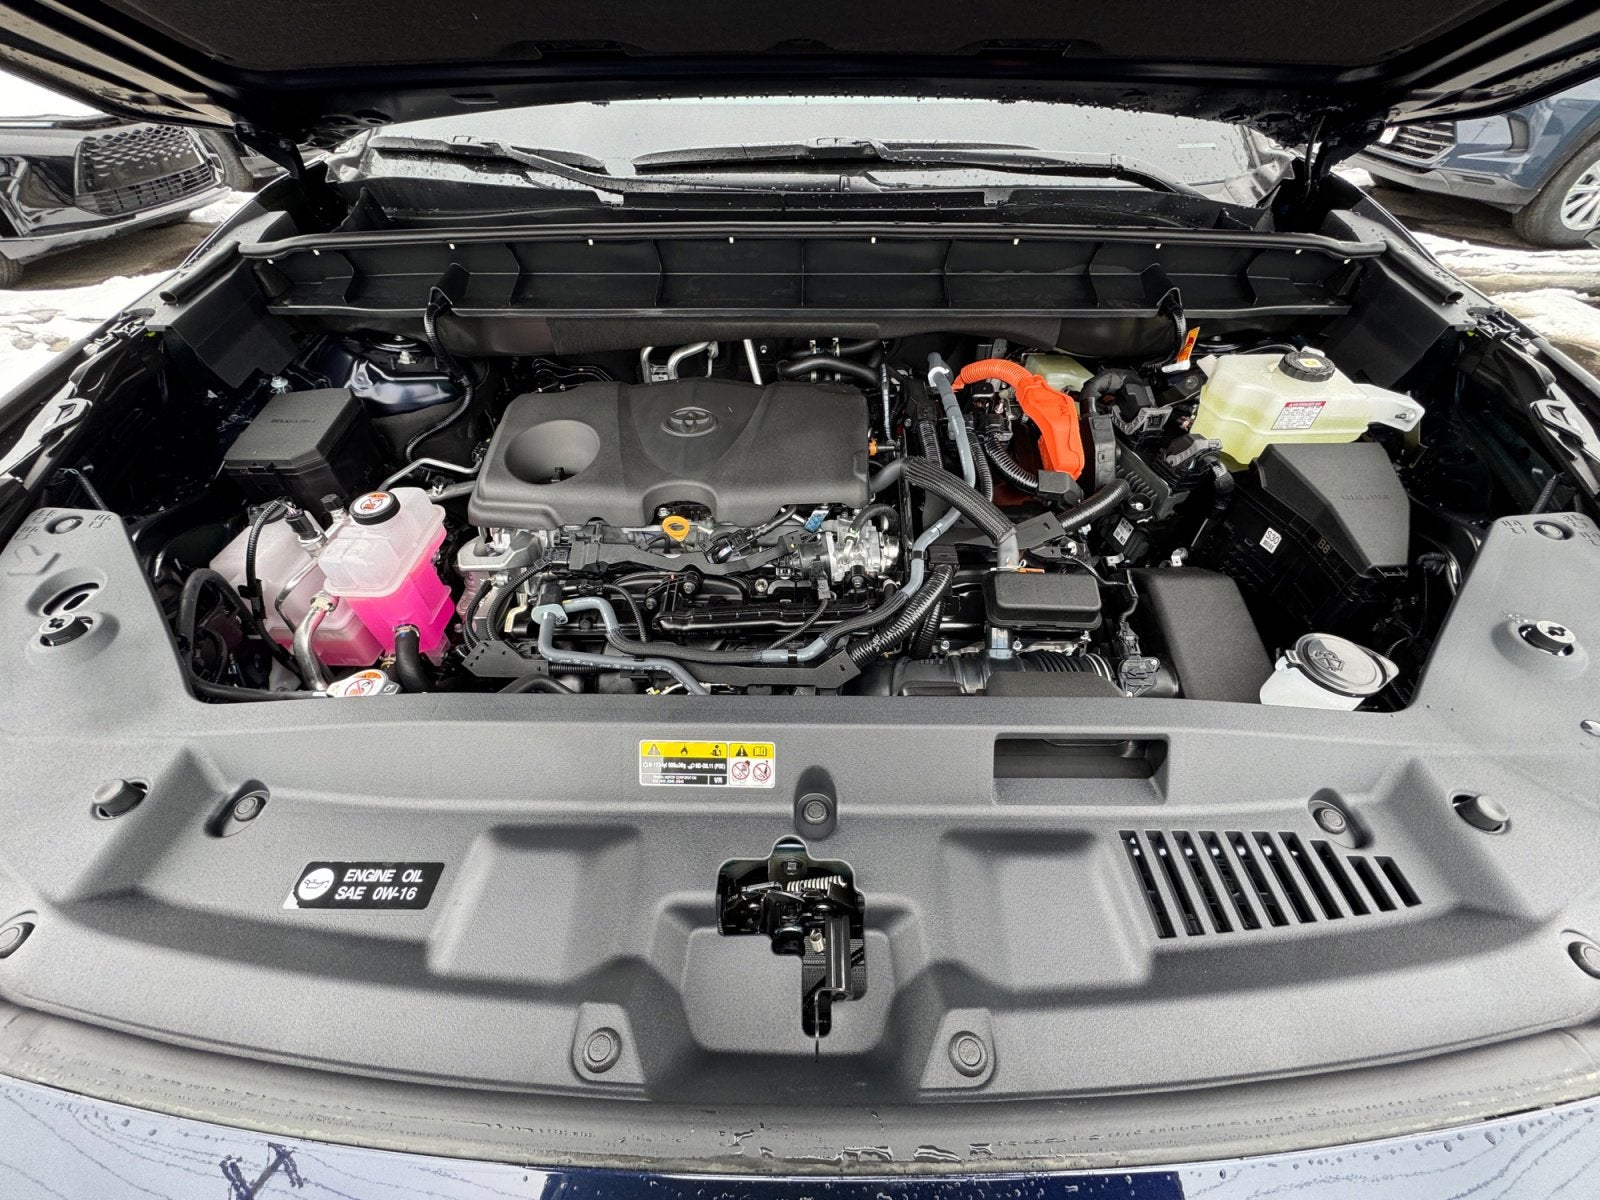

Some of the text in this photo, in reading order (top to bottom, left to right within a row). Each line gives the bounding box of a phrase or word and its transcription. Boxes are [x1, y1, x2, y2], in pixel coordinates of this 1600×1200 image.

[1317, 538, 1331, 554] B8
[343, 869, 424, 883] ENGINE OIL
[334, 886, 418, 900] SAE 0W-16
